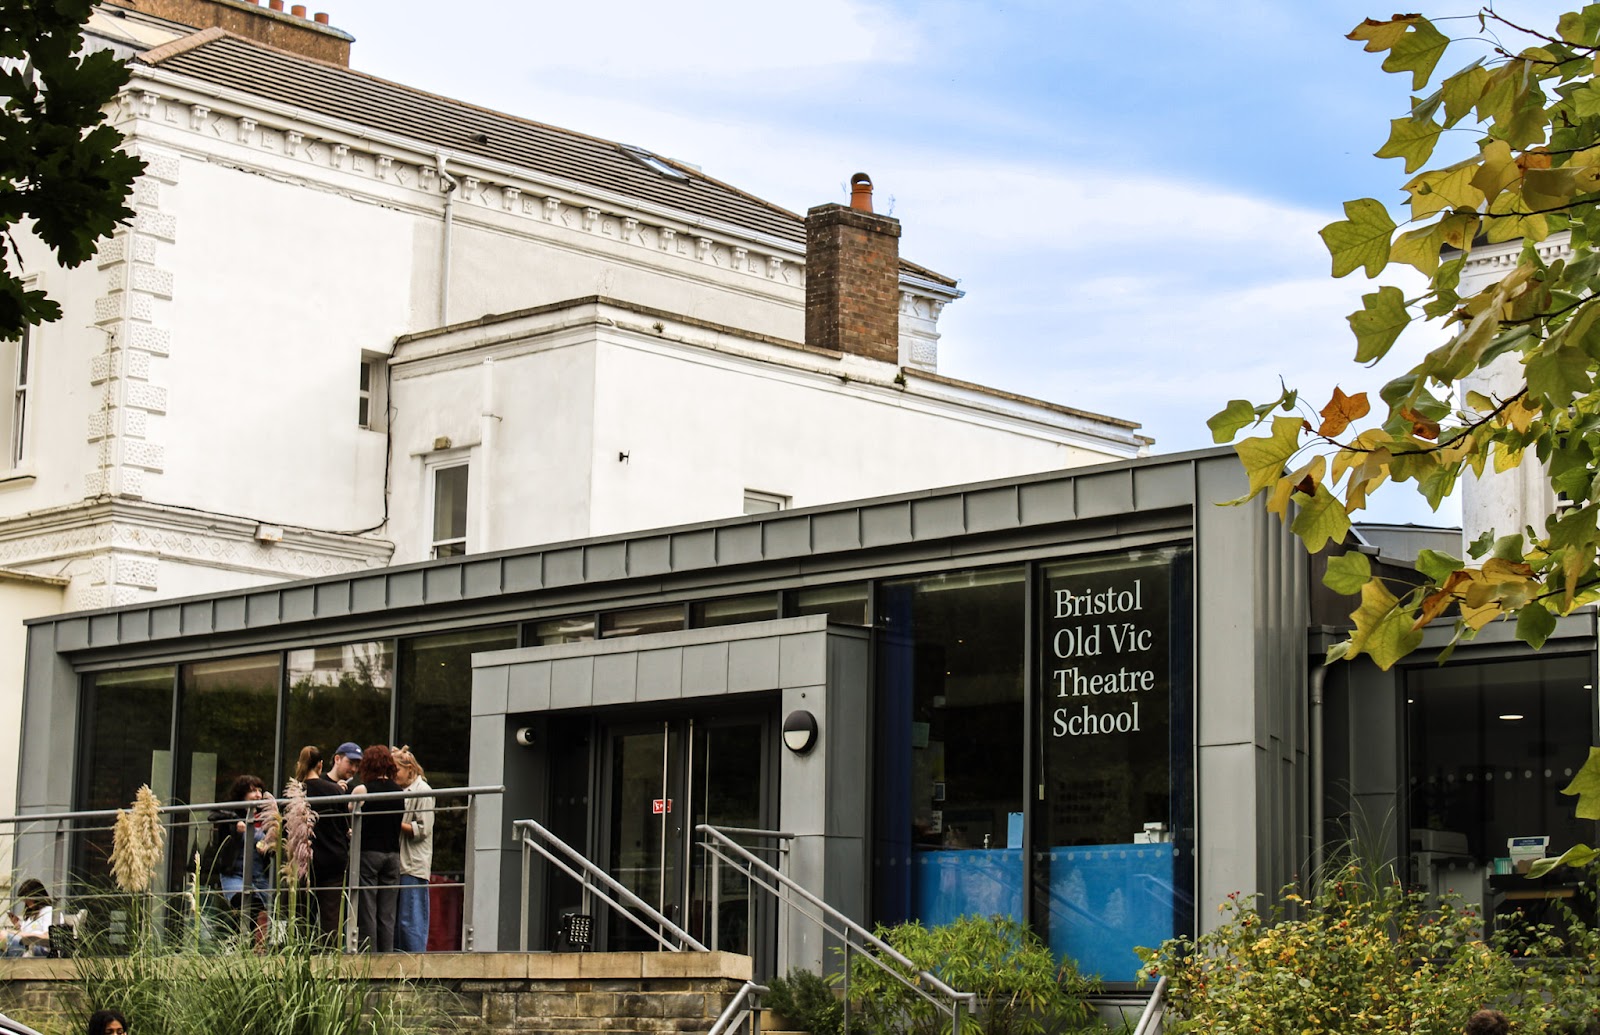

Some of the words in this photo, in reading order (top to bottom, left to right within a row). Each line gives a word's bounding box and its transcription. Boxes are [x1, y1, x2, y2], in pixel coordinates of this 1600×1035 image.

[1053, 579, 1142, 619] Bristol
[1053, 624, 1102, 659] Old
[1107, 622, 1152, 653] Vic
[1053, 666, 1155, 698] Theatre
[1053, 701, 1141, 738] School
